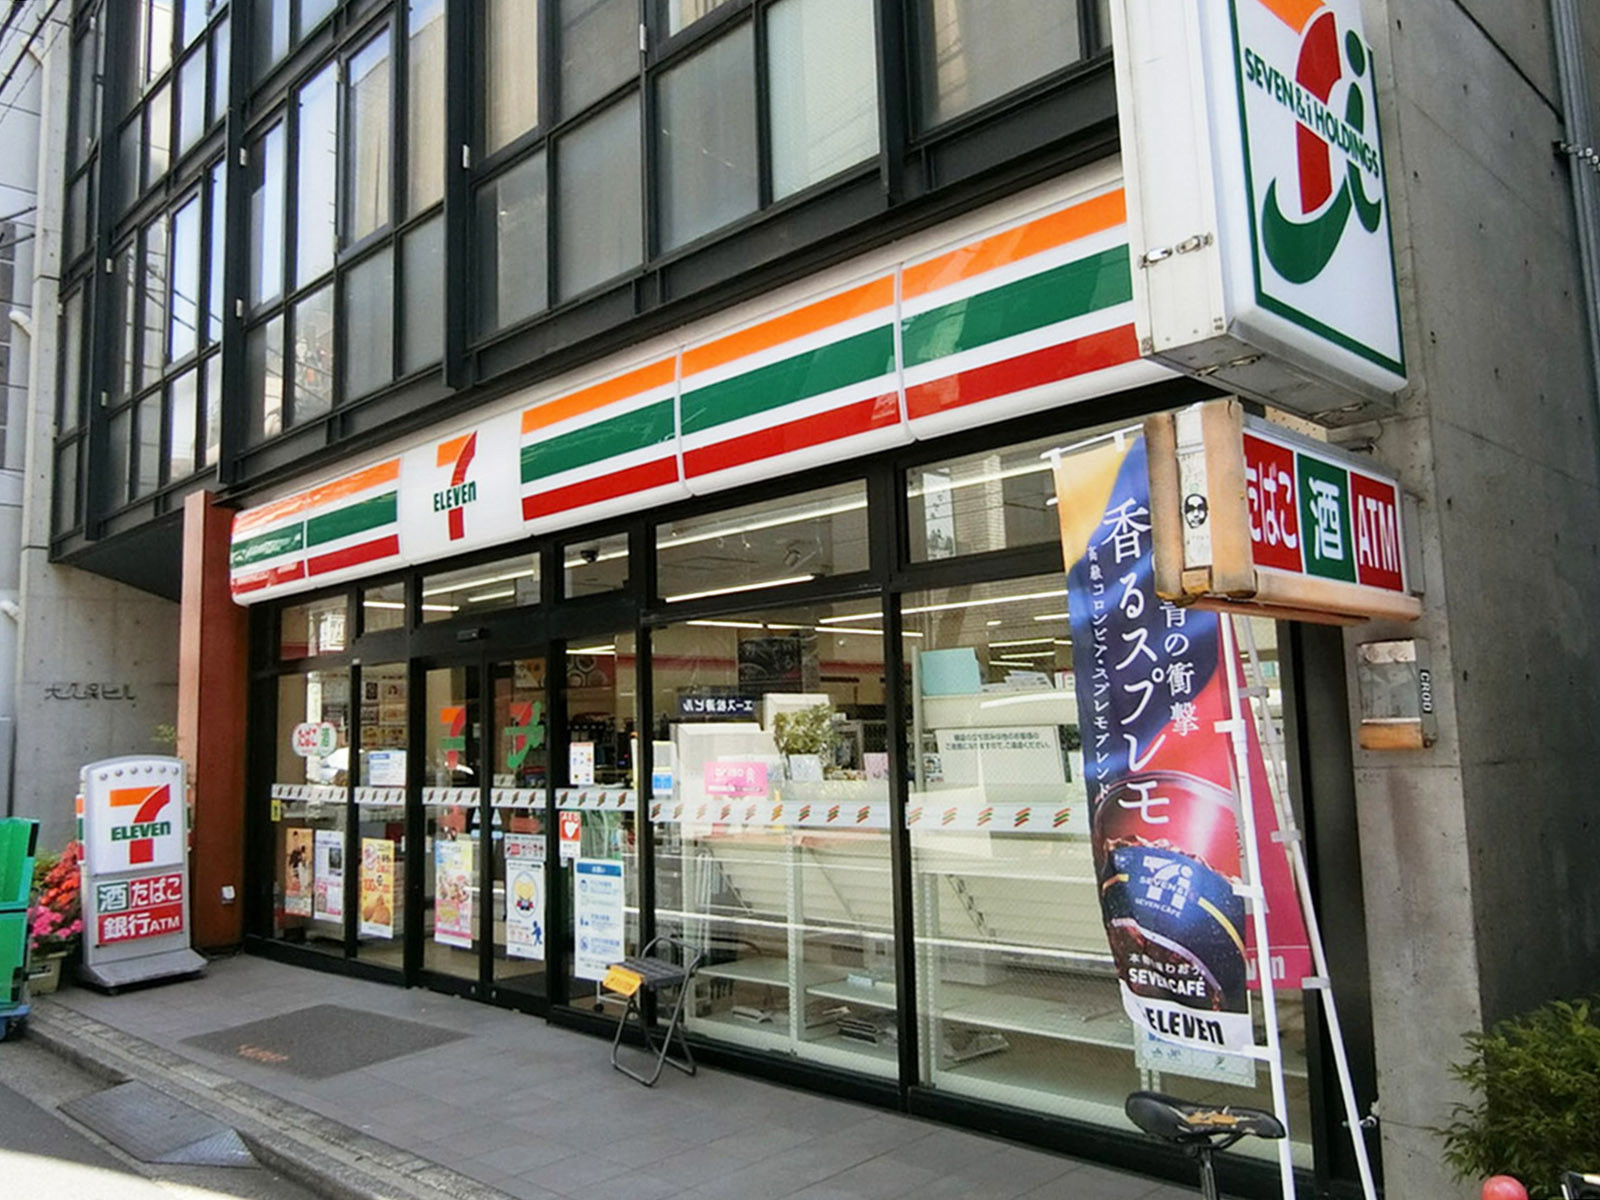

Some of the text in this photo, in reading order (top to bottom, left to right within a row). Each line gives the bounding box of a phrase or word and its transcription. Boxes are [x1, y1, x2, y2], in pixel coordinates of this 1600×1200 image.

[1315, 108, 1380, 178] HOLDINGS
[436, 429, 477, 541] 7
[1308, 475, 1345, 561] 酒
[1356, 494, 1400, 573] ATM
[1100, 497, 1170, 825] 香るスプレモ
[109, 783, 172, 865] 7
[99, 877, 182, 912] 酒 たばこ
